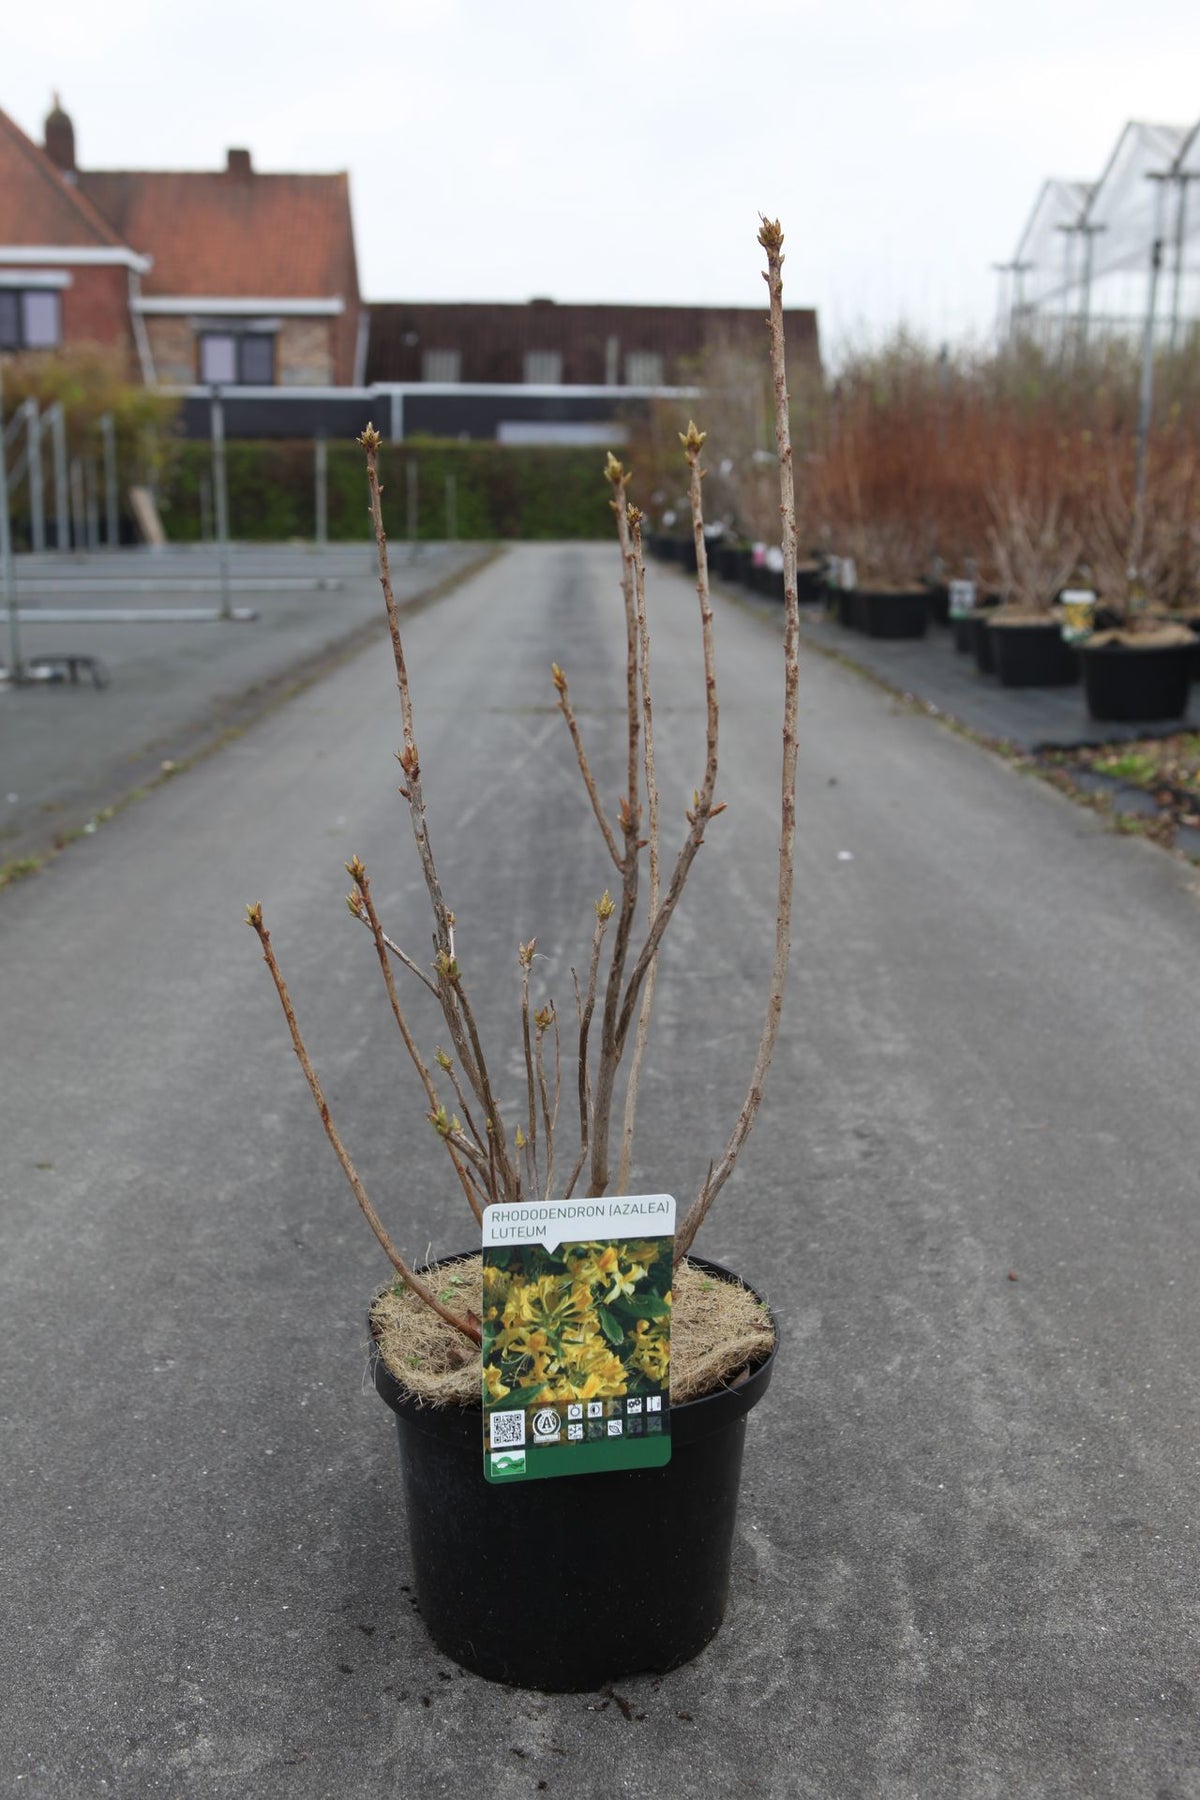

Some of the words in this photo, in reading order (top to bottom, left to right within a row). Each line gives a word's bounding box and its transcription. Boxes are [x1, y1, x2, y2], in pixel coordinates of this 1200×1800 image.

[491, 1205, 605, 1223] RHODODENDRON
[609, 1200, 670, 1217] (AZALEA)
[491, 1225, 547, 1240] LUTEUM
